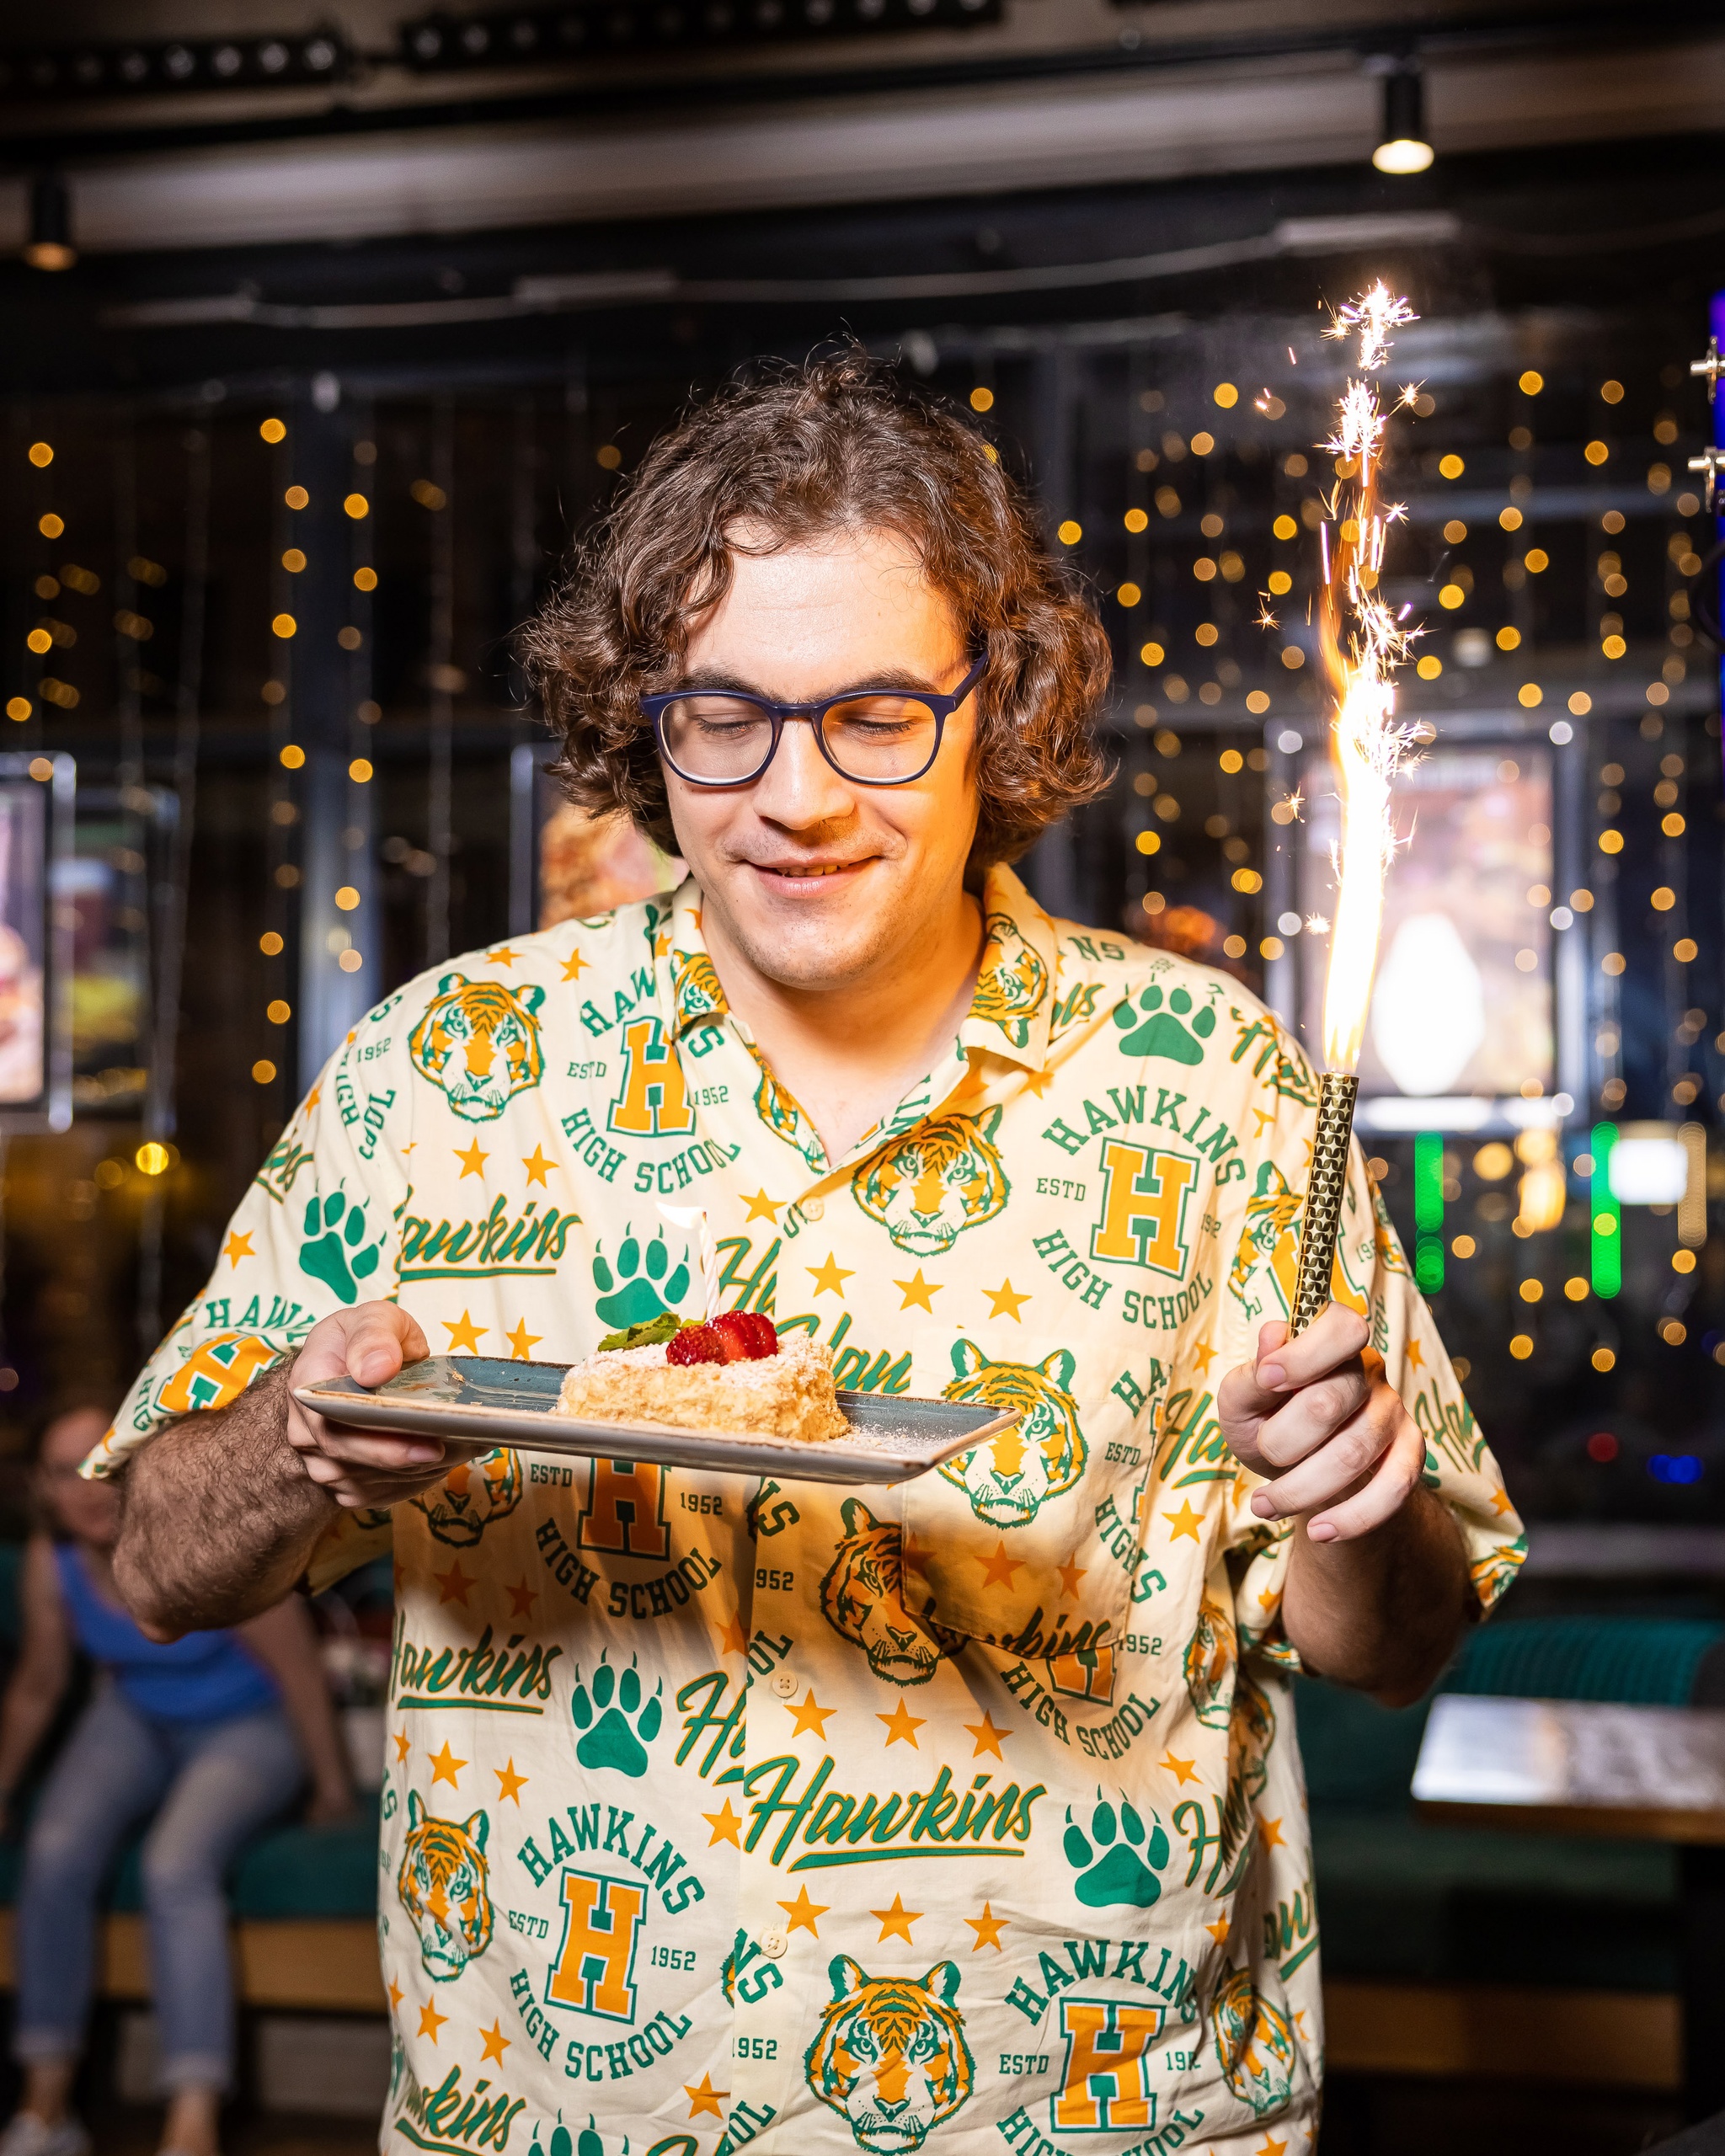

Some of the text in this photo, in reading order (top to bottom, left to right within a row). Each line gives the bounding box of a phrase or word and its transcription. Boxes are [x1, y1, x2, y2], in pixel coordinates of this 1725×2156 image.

[357, 1037, 392, 1063] 1952
[567, 1061, 607, 1080] ESTD
[694, 1086, 729, 1107] 1952
[560, 1107, 741, 1194] HIGH SCHOOL
[1041, 1085, 1246, 1187] HAWKINS
[1036, 1177, 1087, 1202] ESTD
[1089, 1136, 1200, 1282] H
[1032, 1229, 1214, 1330] HIGH SCHOOL
[530, 1463, 573, 1487] ESTD
[1104, 1441, 1141, 1466] ESTD
[679, 1492, 724, 1517] 1952
[535, 1518, 723, 1620] HIGH SCHOOL
[755, 1568, 794, 1592] 952
[999, 1660, 1071, 1746] HIGH
[1075, 1692, 1162, 1760] SCHOOL
[742, 1753, 1049, 1867] Hawkins
[516, 1802, 706, 1915] HAWKINS
[508, 1910, 550, 1940] ESTD
[543, 1866, 649, 2025] H
[650, 1945, 697, 1972] 1952
[509, 1967, 693, 2082] HIGH SCHOOL
[999, 2053, 1050, 2075] ESTD
[1050, 1996, 1167, 2134] H
